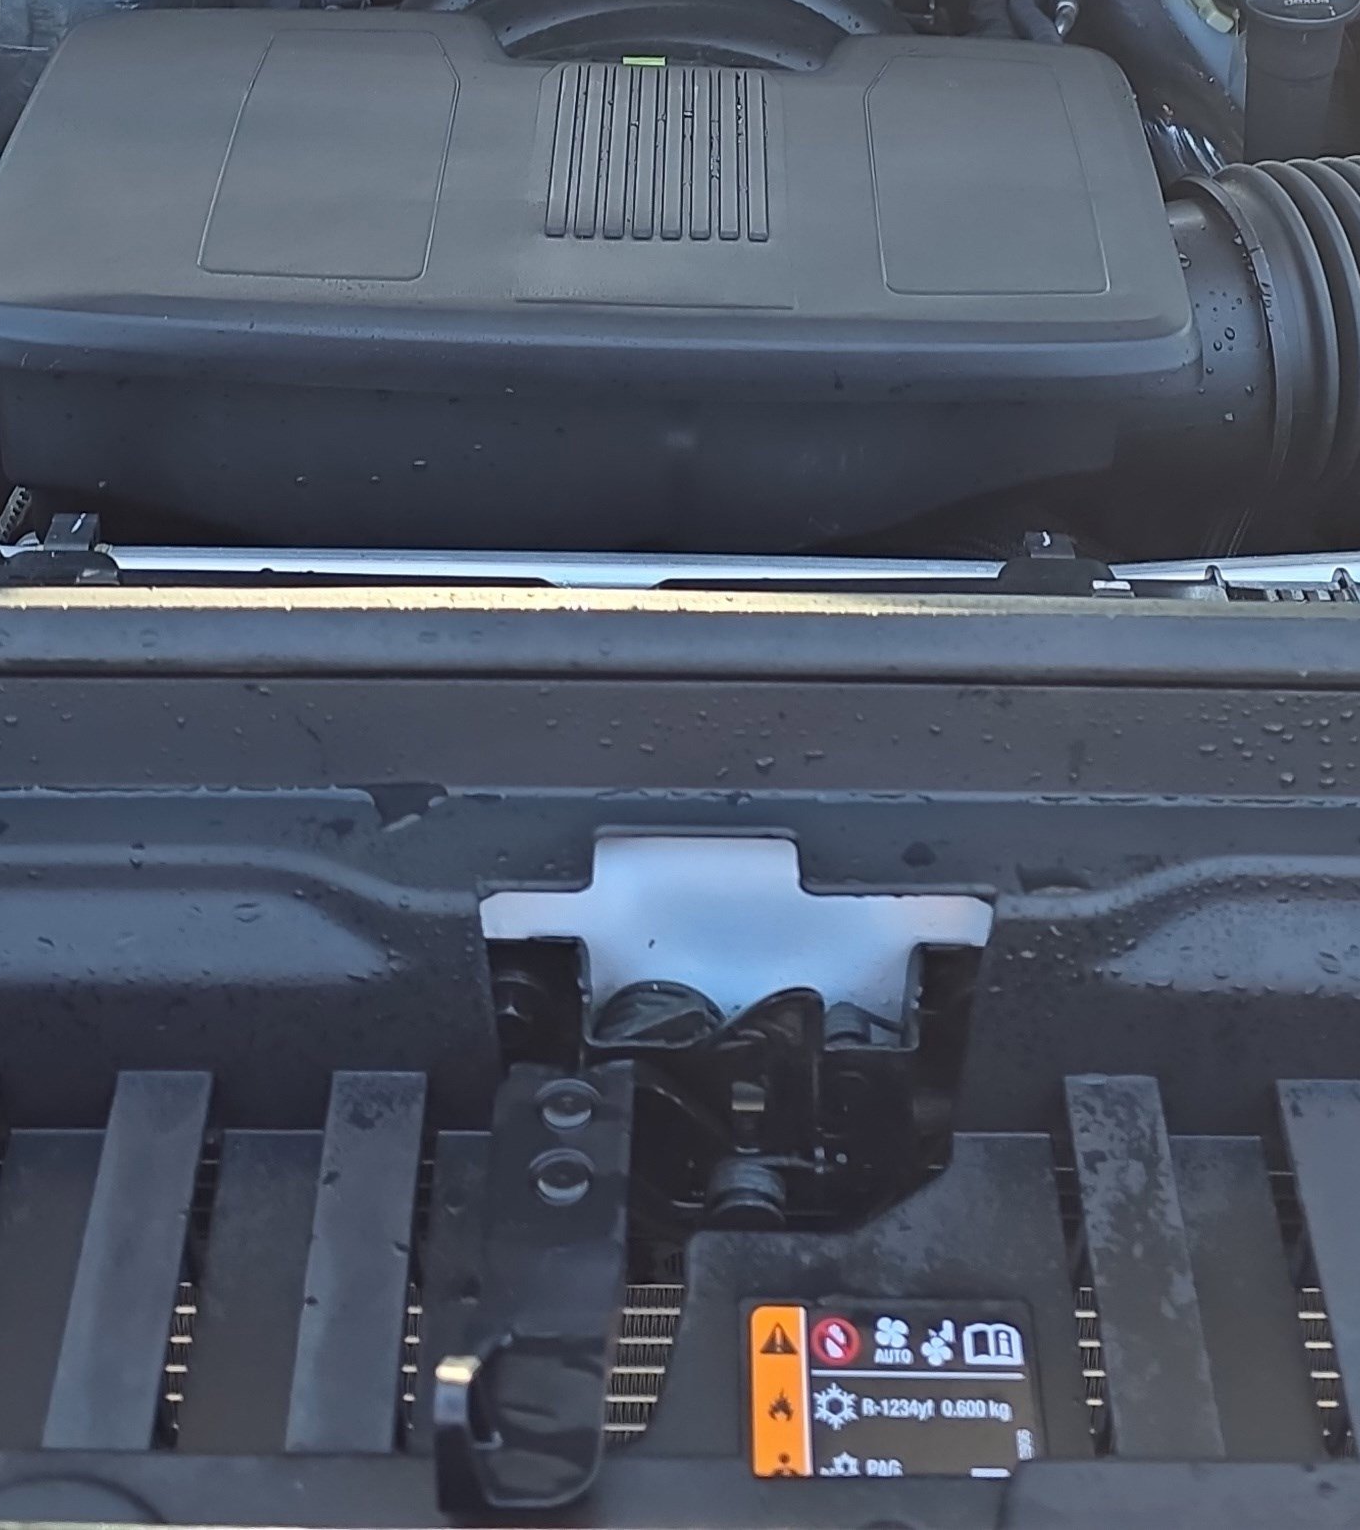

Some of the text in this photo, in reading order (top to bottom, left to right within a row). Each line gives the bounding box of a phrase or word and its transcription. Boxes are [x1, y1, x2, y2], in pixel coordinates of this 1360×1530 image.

[873, 1348, 914, 1365] AUTO
[861, 1397, 1014, 1423] R-1234yf 0.600 kg
[865, 1458, 904, 1476] PAG
